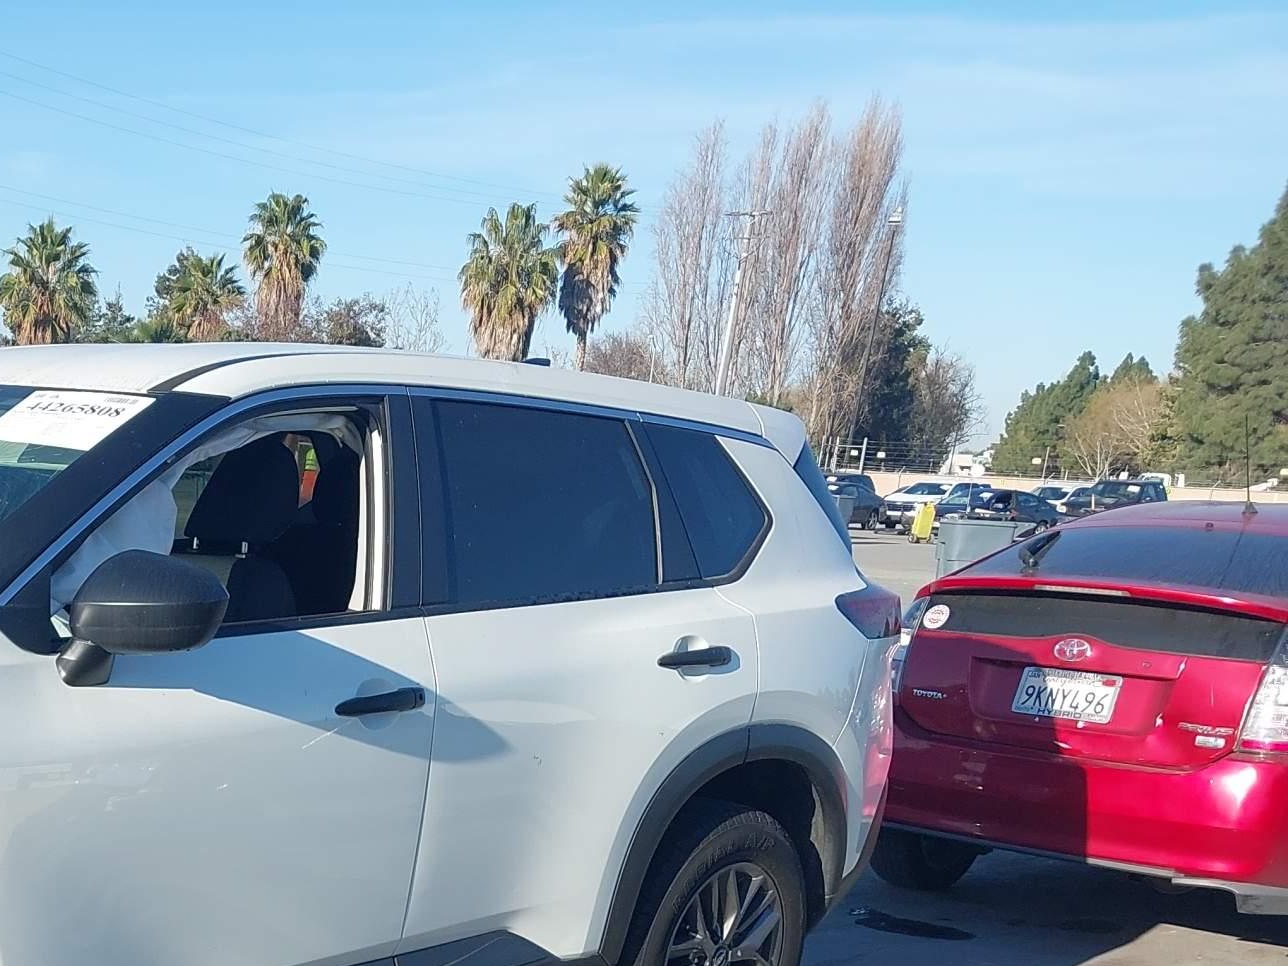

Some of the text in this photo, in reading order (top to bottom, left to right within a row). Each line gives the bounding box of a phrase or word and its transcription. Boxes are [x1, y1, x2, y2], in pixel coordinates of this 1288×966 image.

[25, 401, 126, 418] 44265808
[1020, 684, 1110, 715] 9KNY496
[1037, 707, 1082, 718] HYBRID
